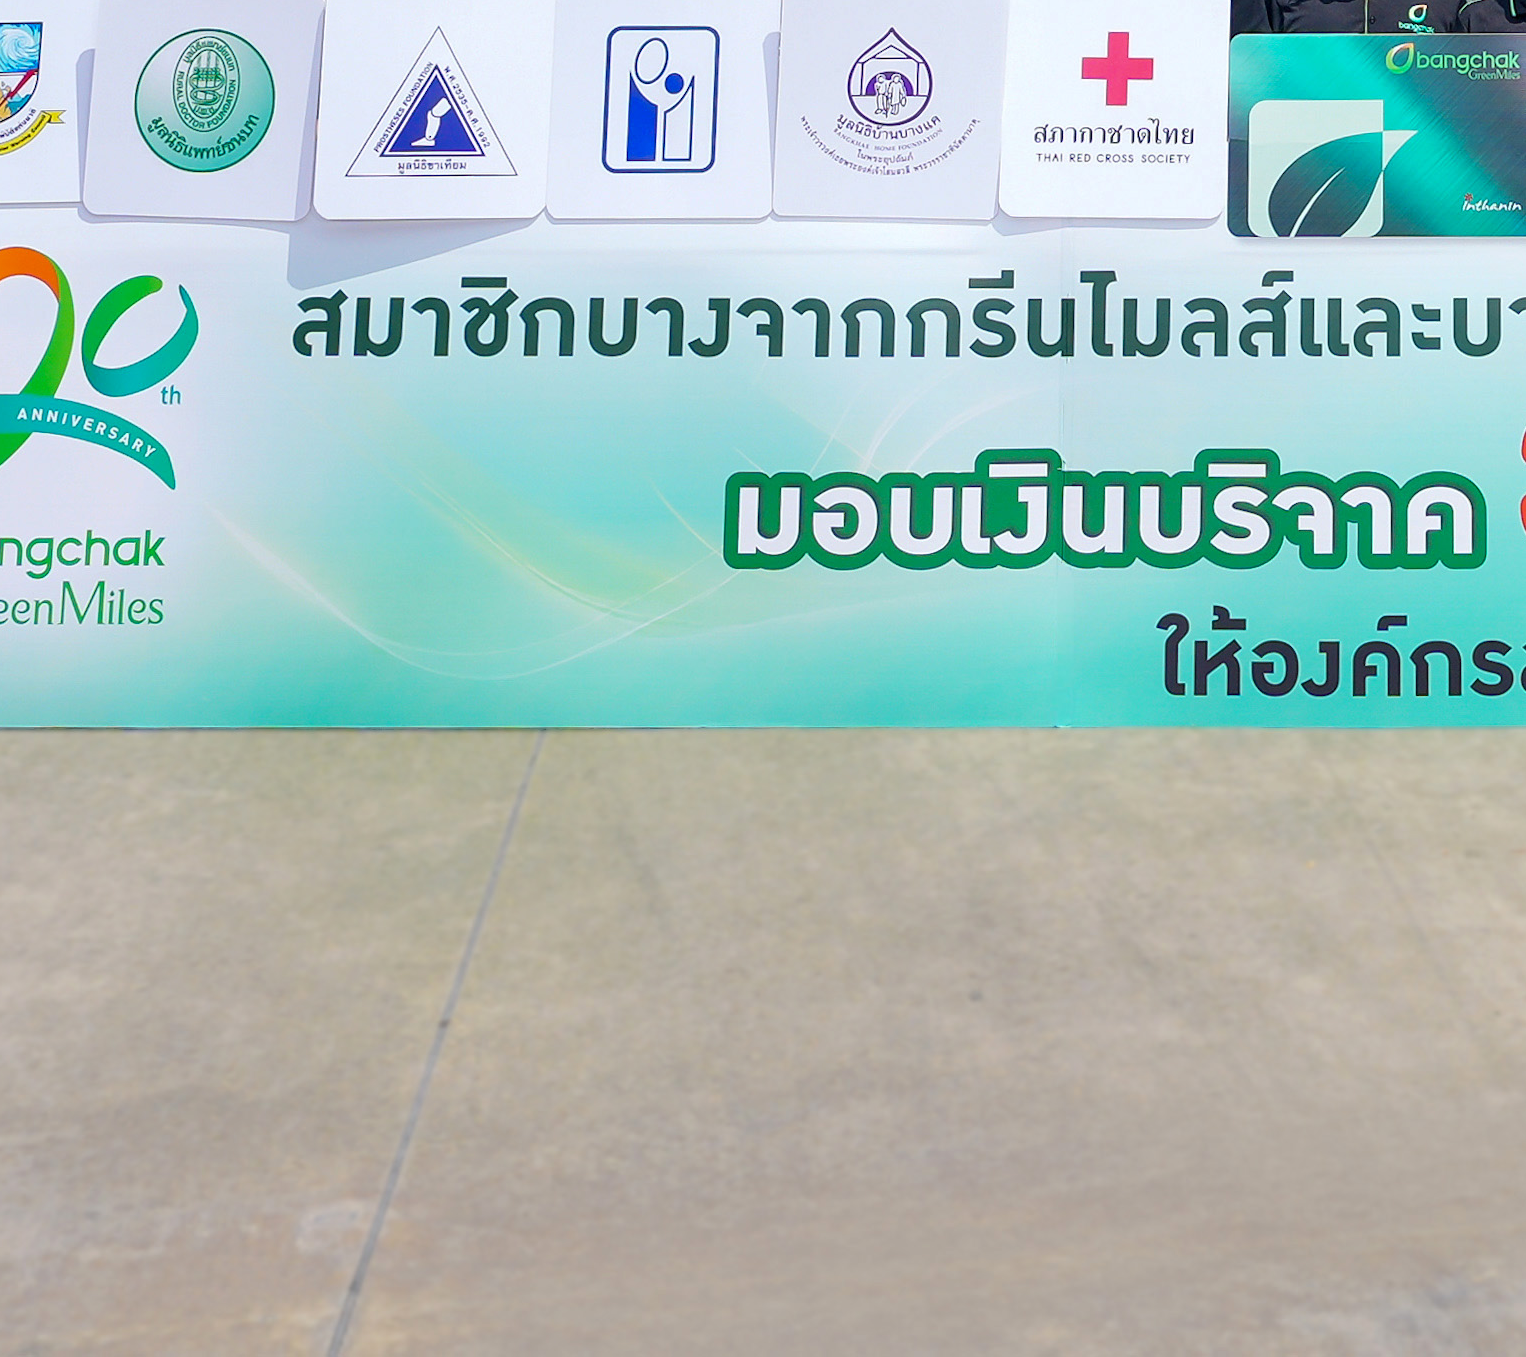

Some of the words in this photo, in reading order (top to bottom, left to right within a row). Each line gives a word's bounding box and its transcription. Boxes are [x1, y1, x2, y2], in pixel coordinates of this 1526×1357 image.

[1416, 51, 1521, 75] bangchak
[1468, 68, 1521, 80] GreenMiles
[175, 70, 185, 100] RURAL
[178, 102, 205, 129] DOCTOR
[207, 79, 236, 128] FOUNDATION
[373, 107, 405, 153] PROSTHESES
[402, 62, 434, 107] FOUNDATION
[147, 114, 260, 159] มูลนิธิแพทย์ชนบท
[834, 113, 942, 140] มูลนิธิบ้านบางแค
[898, 128, 944, 151] FOUNDATION
[1032, 117, 1195, 146] สภากาชาดไทย
[1036, 153, 1063, 163] THAI
[1069, 153, 1091, 163] RED
[1096, 153, 1134, 163] CROSS
[1141, 154, 1191, 164] SOCIETY
[17, 407, 158, 459] ANNIVERSARY
[728, 452, 1484, 567] มอบเงินบริจาค
